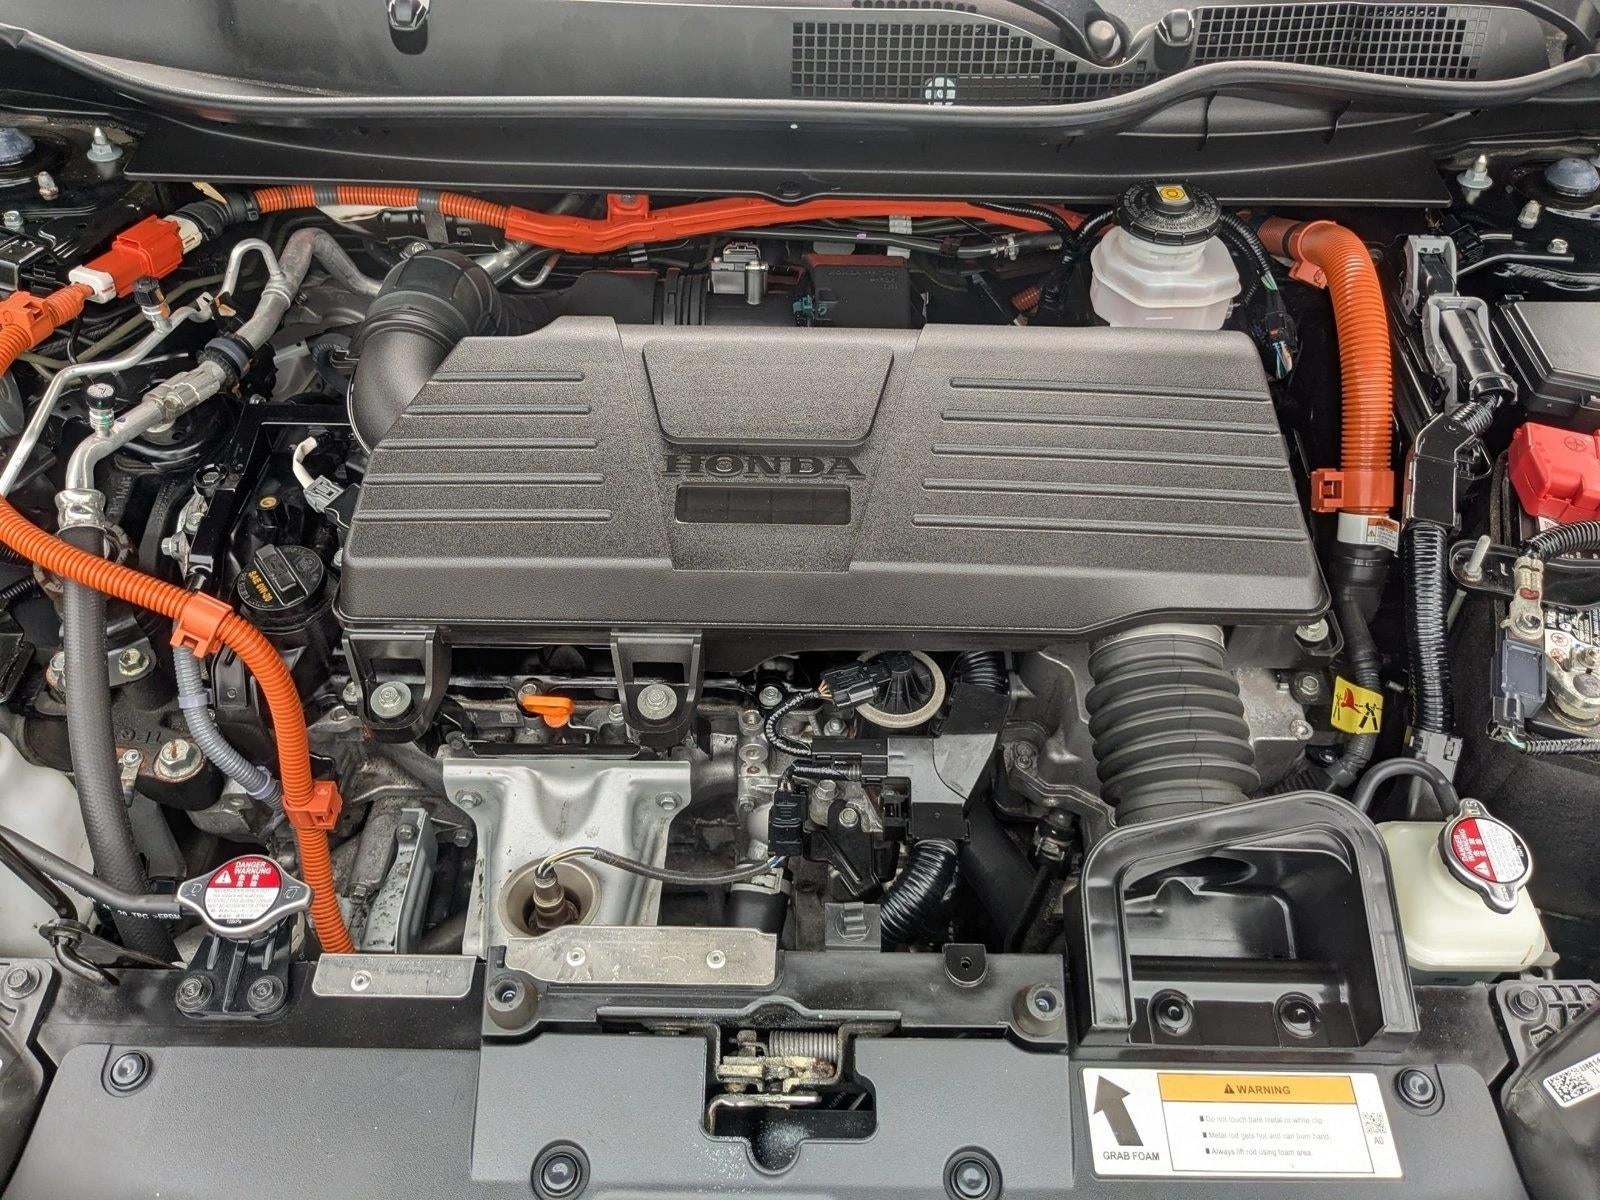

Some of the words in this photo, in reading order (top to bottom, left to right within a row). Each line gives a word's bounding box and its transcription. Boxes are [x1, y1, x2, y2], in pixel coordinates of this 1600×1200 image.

[662, 453, 866, 480] HONDA
[248, 570, 262, 585] SAE
[256, 583, 273, 602] 0W-20
[234, 867, 272, 875] WARNUNG
[1236, 1084, 1291, 1095] WARNING
[1228, 1115, 1247, 1123] touch
[1248, 1115, 1263, 1123] bare
[1293, 1116, 1310, 1124] white
[1208, 1131, 1226, 1139] Metal
[1240, 1132, 1255, 1141] gets
[1269, 1132, 1281, 1140] and
[1102, 1150, 1130, 1161] GRAB
[1132, 1151, 1160, 1161] FOAM
[1211, 1147, 1235, 1156] Always
[1259, 1149, 1277, 1157] using
